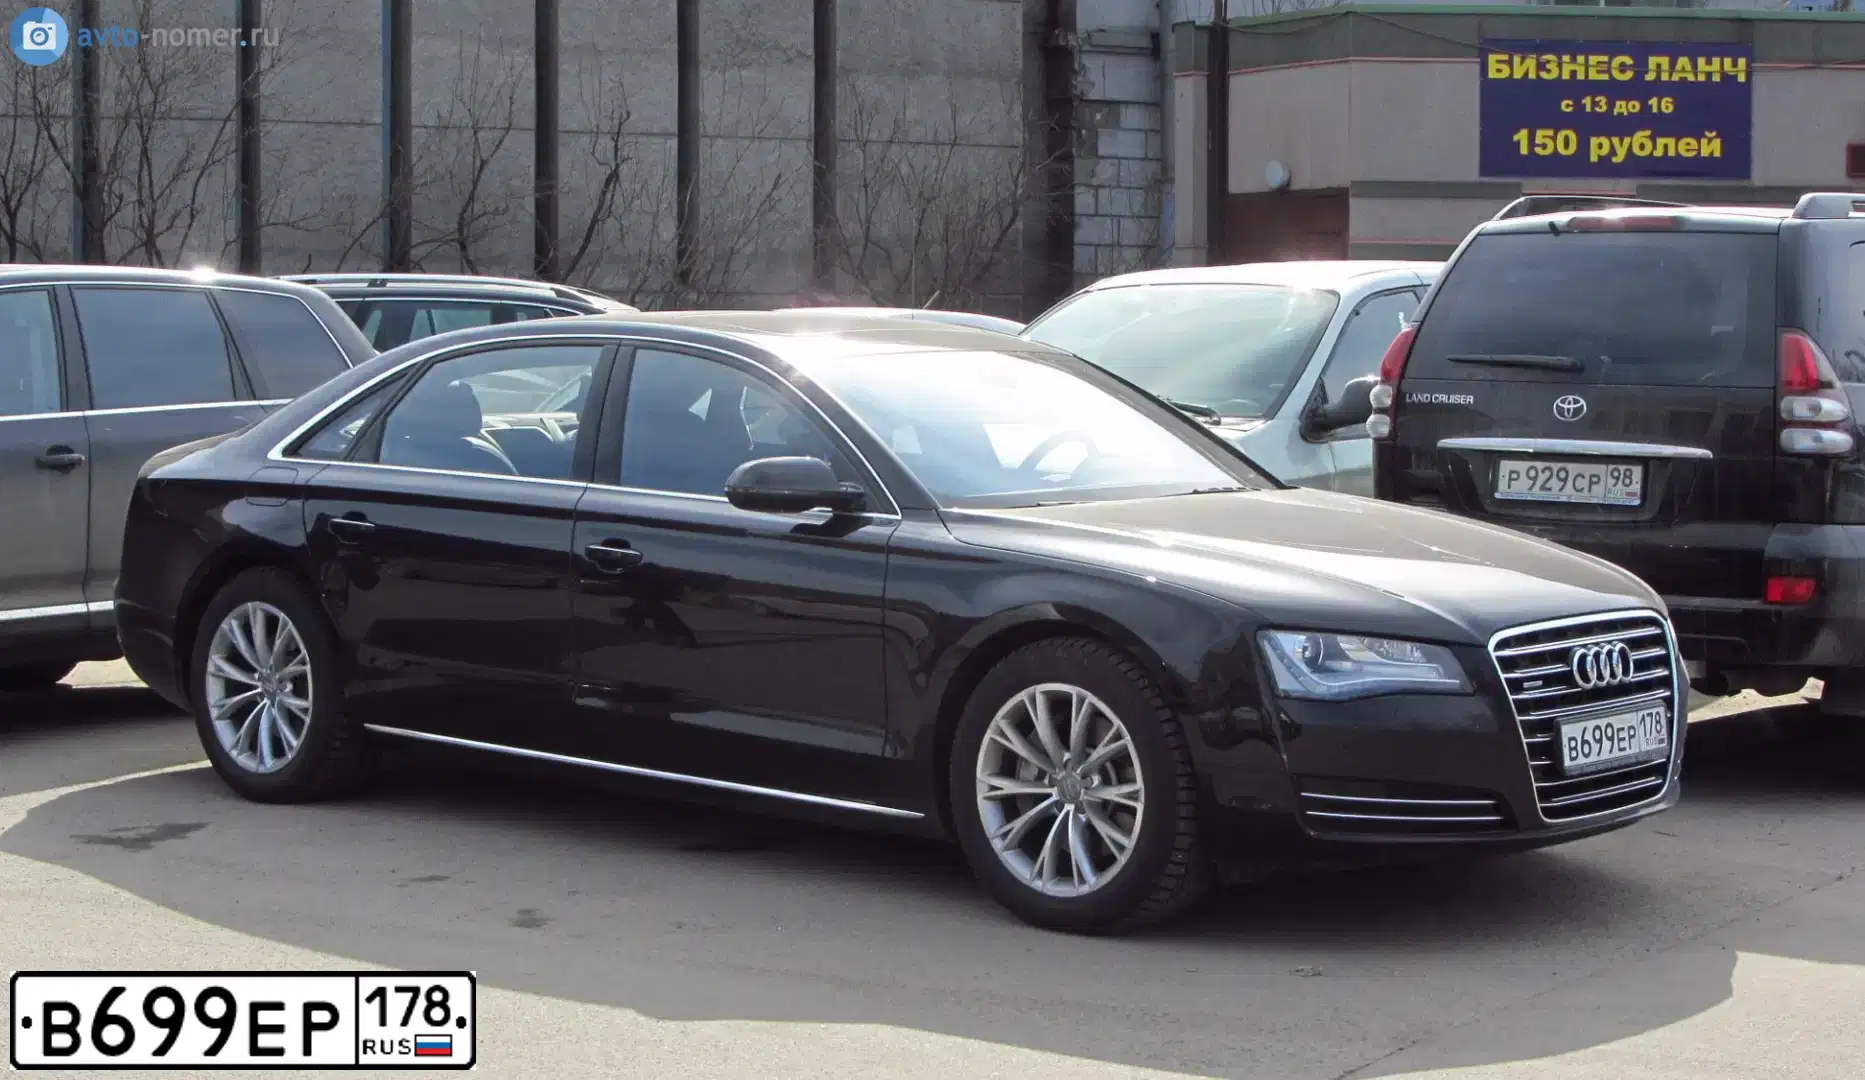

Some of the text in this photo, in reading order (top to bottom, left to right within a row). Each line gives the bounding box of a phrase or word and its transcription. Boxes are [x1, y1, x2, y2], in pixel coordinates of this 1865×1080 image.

[1487, 53, 1747, 82] БИЗНЕС ЛАНЧ
[1560, 95, 1675, 116] с 13 до 16
[1512, 128, 1722, 163] 150 рублей
[1405, 392, 1474, 405] LAND CRUISER
[1610, 467, 1633, 488] 98
[1639, 710, 1663, 738] 178
